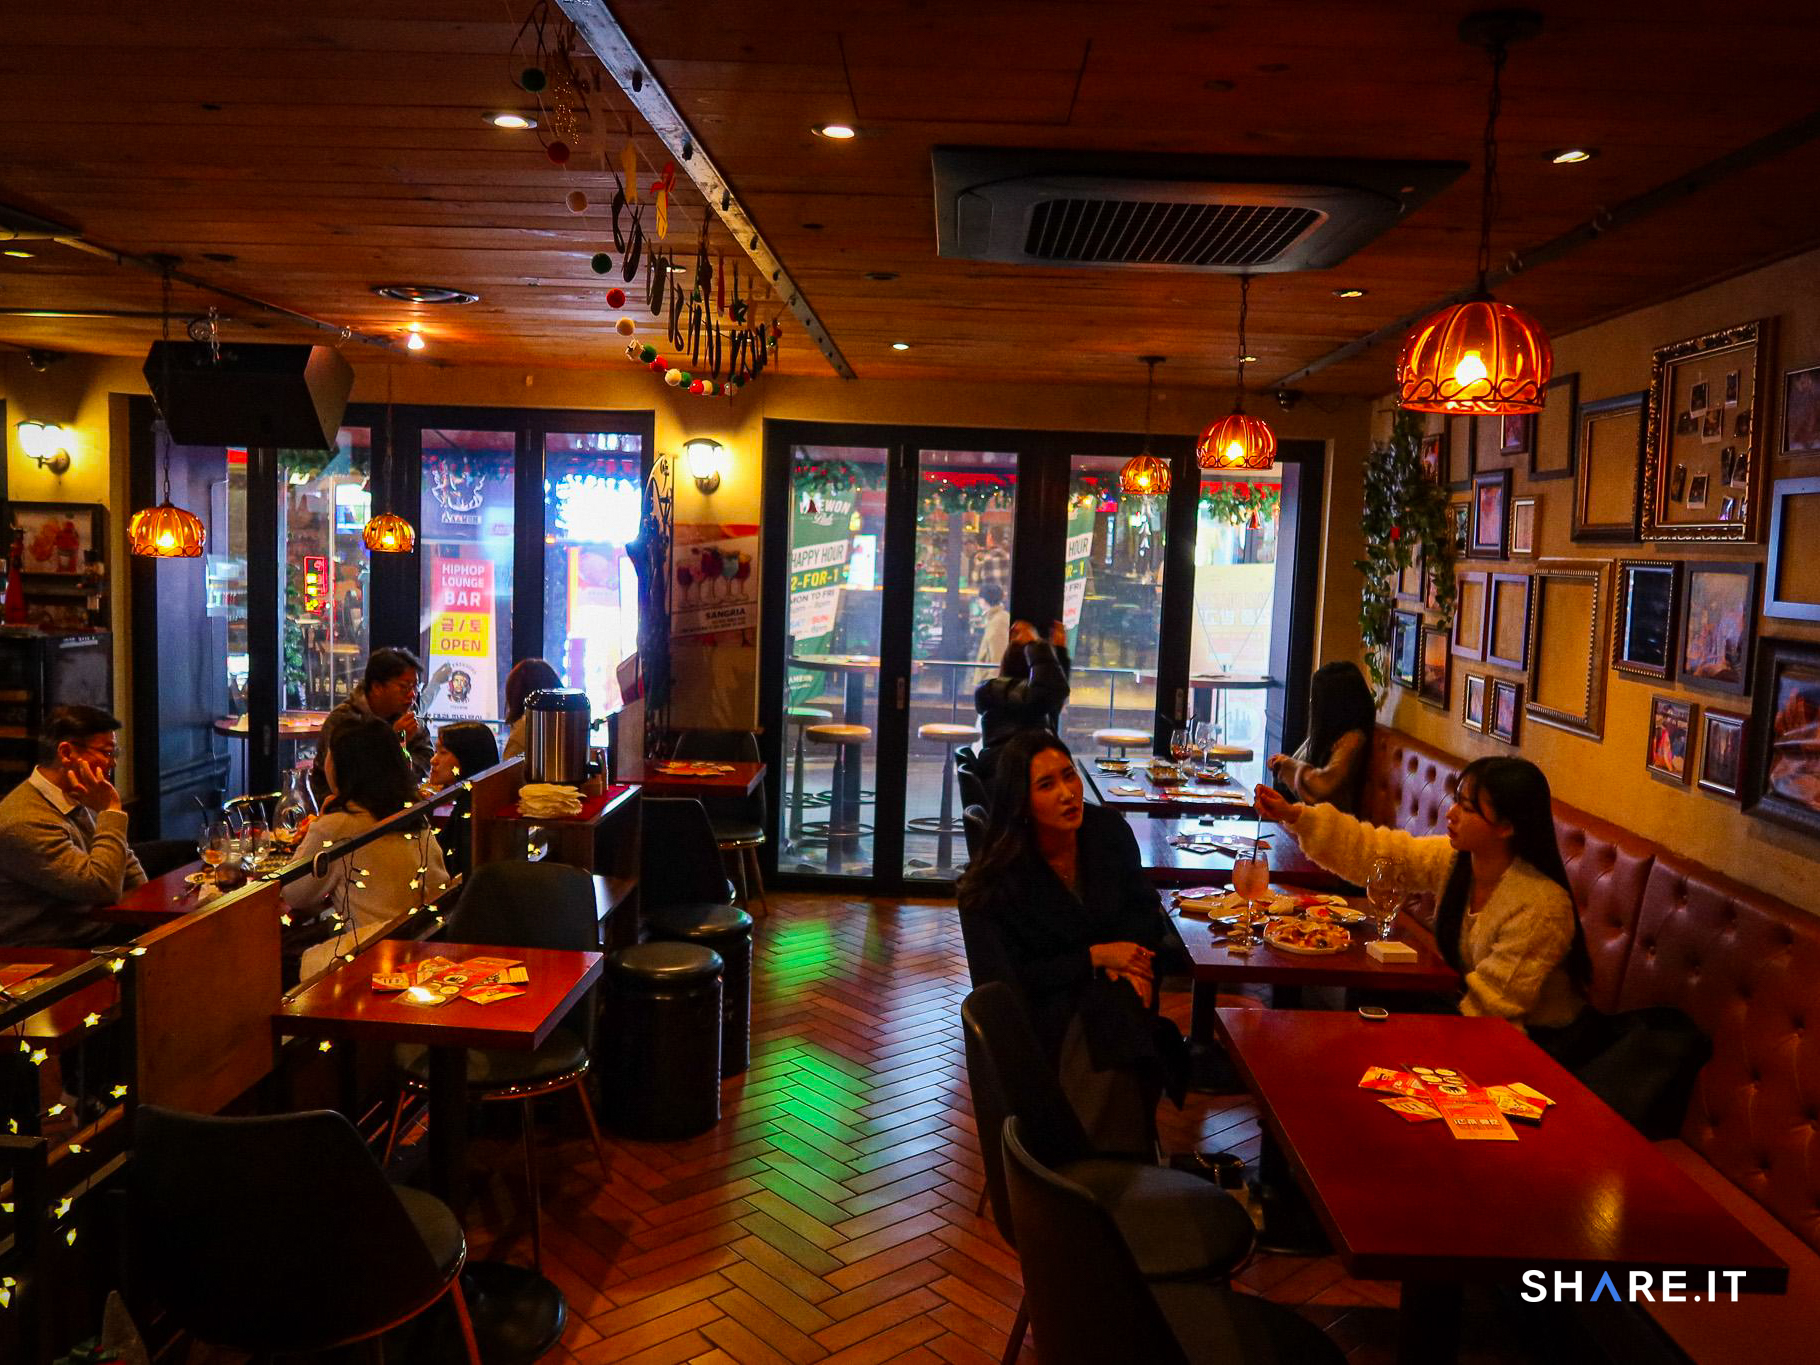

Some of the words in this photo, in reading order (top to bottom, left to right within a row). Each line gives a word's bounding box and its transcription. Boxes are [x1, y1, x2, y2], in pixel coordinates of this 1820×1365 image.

[1068, 538, 1089, 557] HOUR
[791, 547, 819, 569] HAPPY
[821, 543, 844, 563] HOUR
[442, 564, 484, 576] HIPHOP
[442, 576, 484, 588] LOUNGE
[791, 568, 839, 592] 2-FOR-1
[811, 591, 822, 601] TO
[822, 588, 835, 599] FRI
[1069, 583, 1081, 592] FRI
[445, 591, 481, 607] BAR
[706, 608, 746, 619] SANGRIA
[442, 618, 455, 633] 금
[459, 619, 465, 633] /
[469, 618, 482, 634] 토
[441, 638, 481, 652] OPEN
